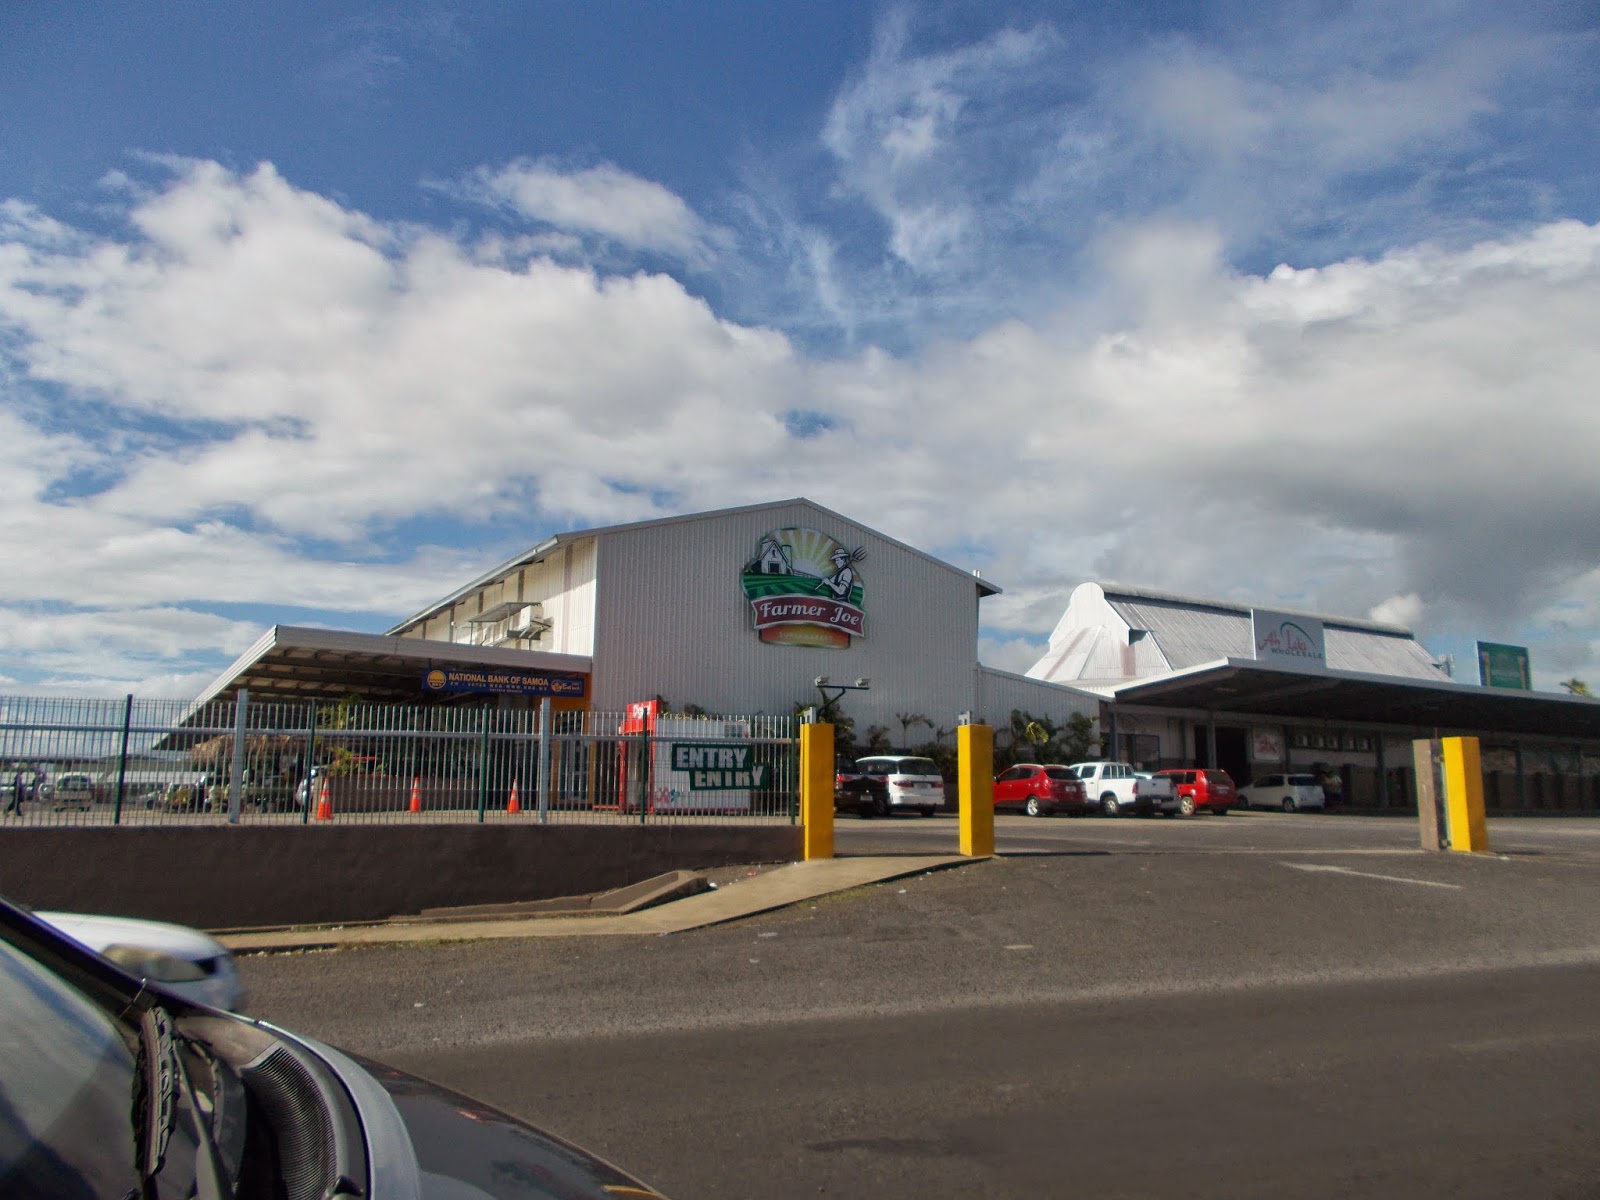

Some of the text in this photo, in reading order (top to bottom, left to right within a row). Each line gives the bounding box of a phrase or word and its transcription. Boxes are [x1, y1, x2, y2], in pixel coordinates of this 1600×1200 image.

[760, 602, 860, 625] Farmer Joe
[1271, 648, 1323, 659] WHOLESALE
[449, 673, 485, 682] NATIONAL
[488, 675, 508, 684] BANK
[522, 678, 549, 686] SAMOA
[676, 747, 747, 768] ENTRY
